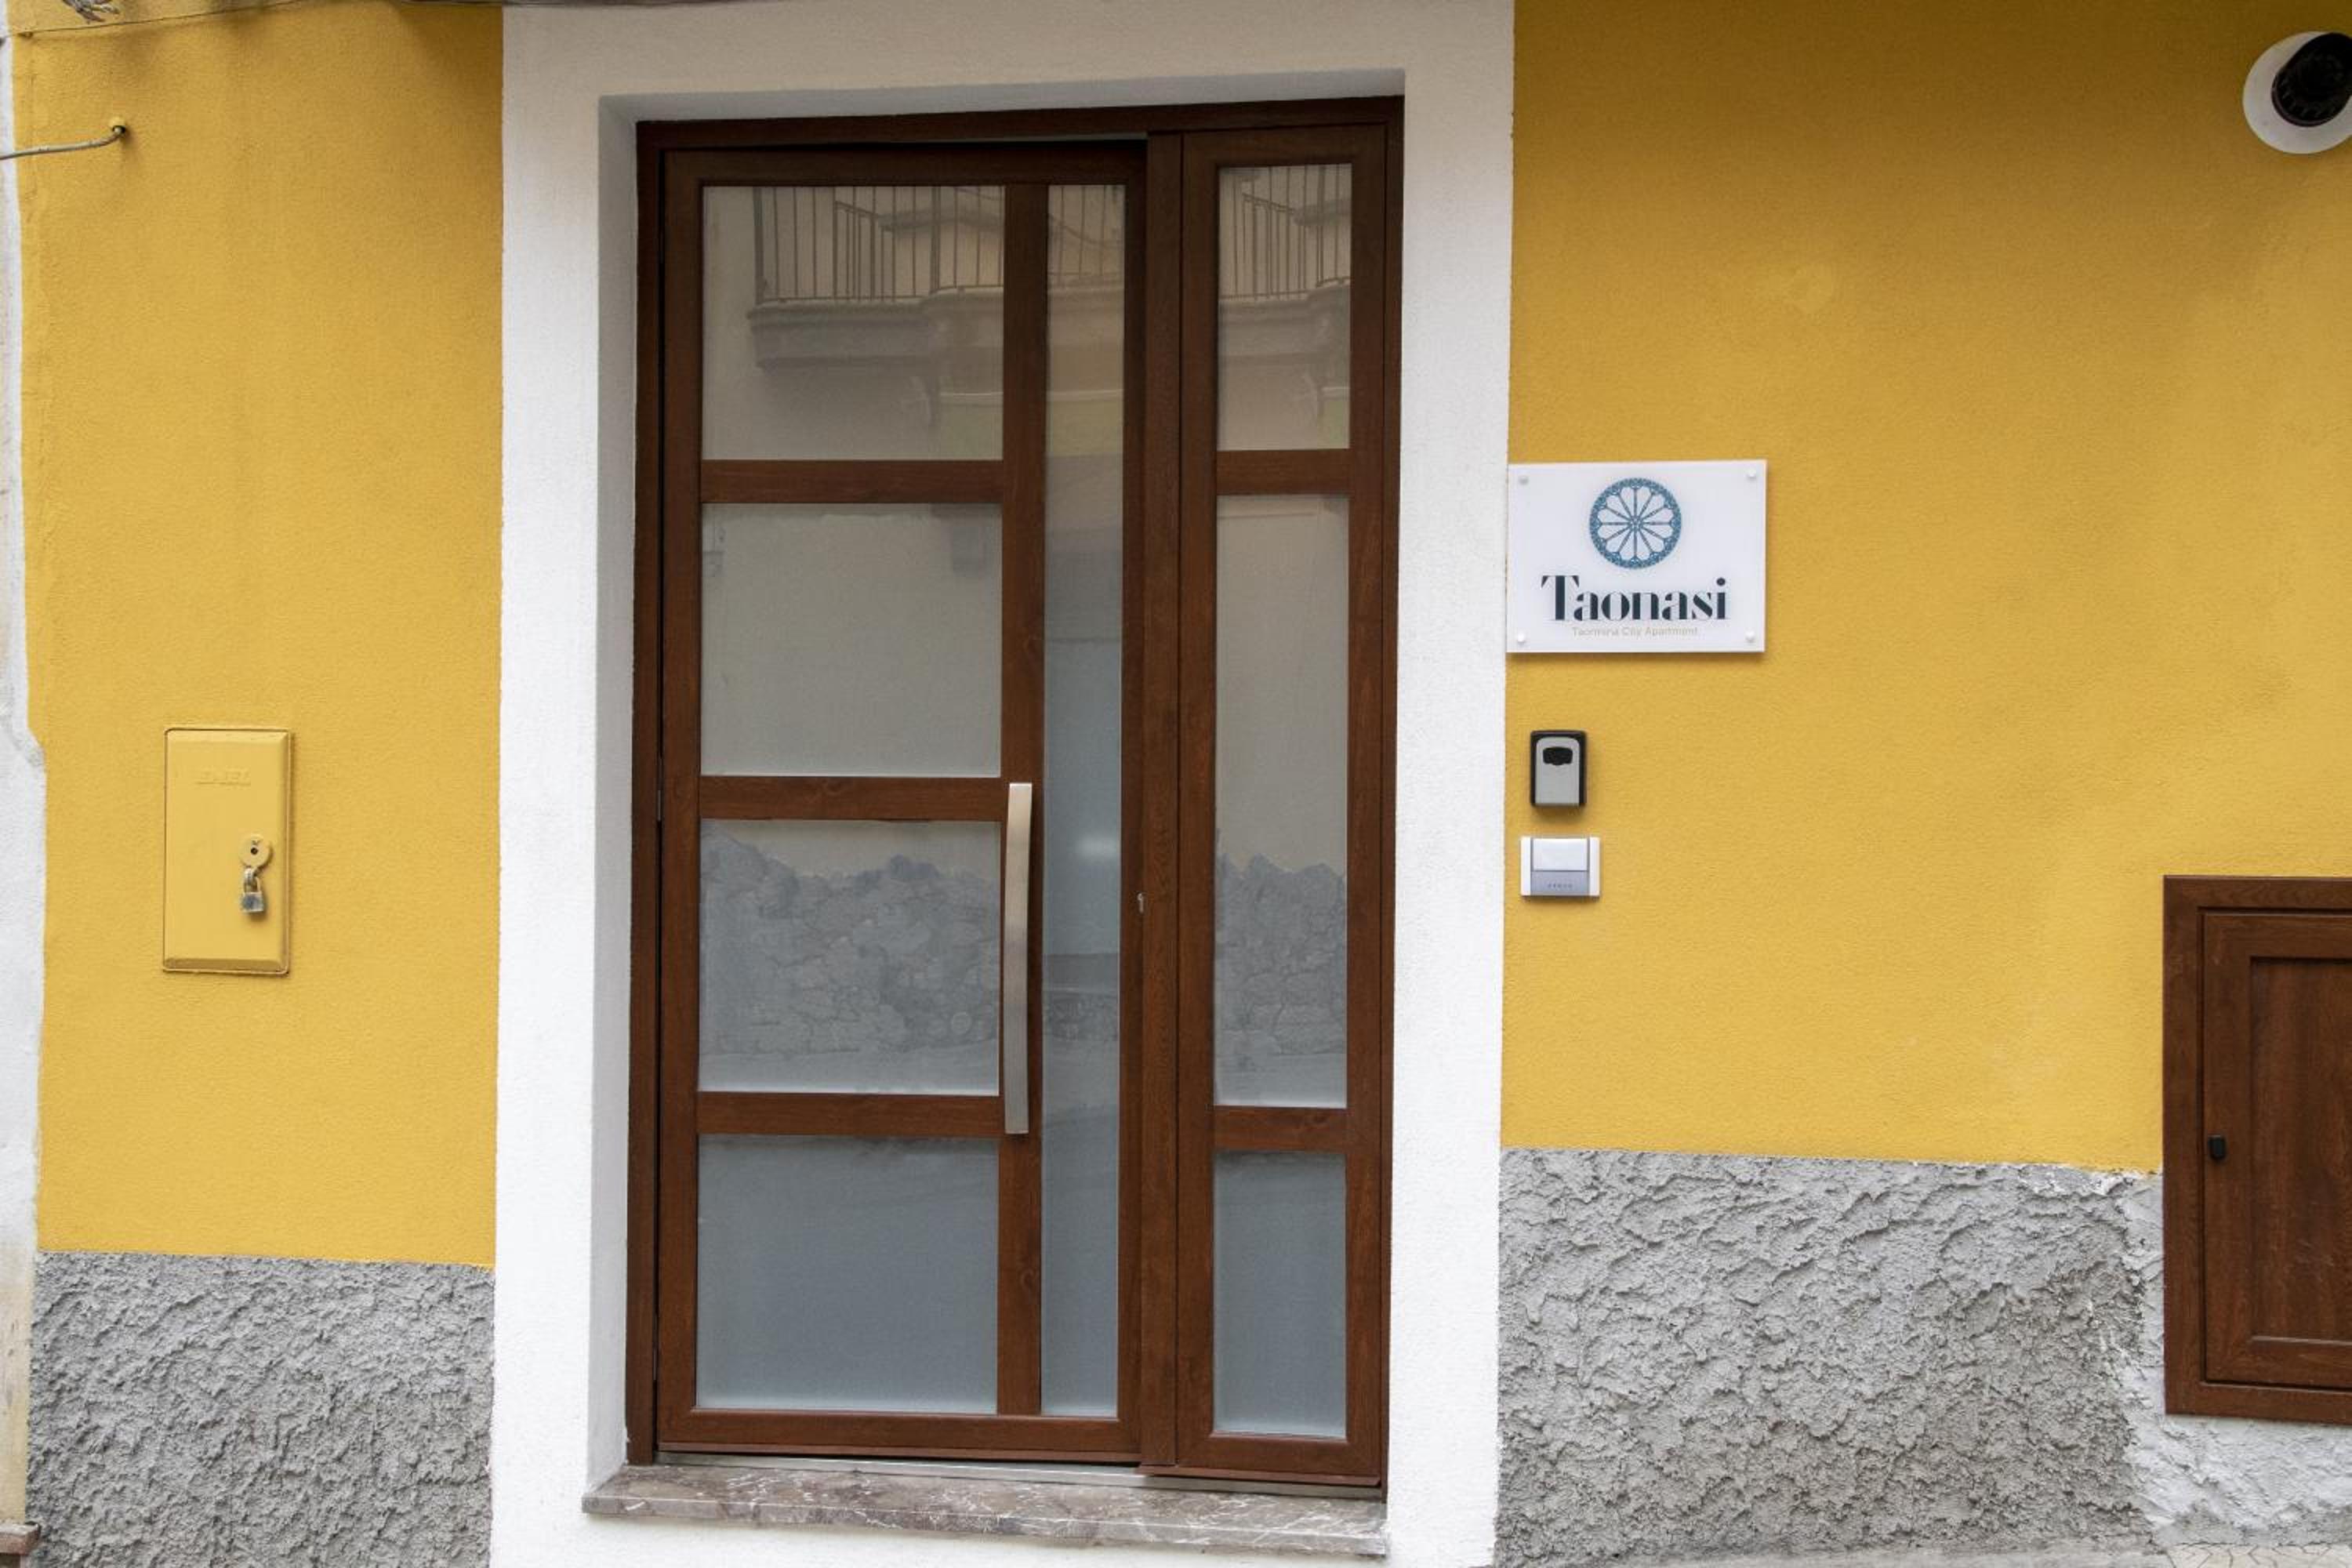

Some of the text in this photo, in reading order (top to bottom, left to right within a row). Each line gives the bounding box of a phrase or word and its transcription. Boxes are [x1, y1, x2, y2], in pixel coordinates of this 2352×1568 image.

[1541, 575, 1730, 622] Taonasi
[1572, 626, 1698, 639] Taormina City Apartment
